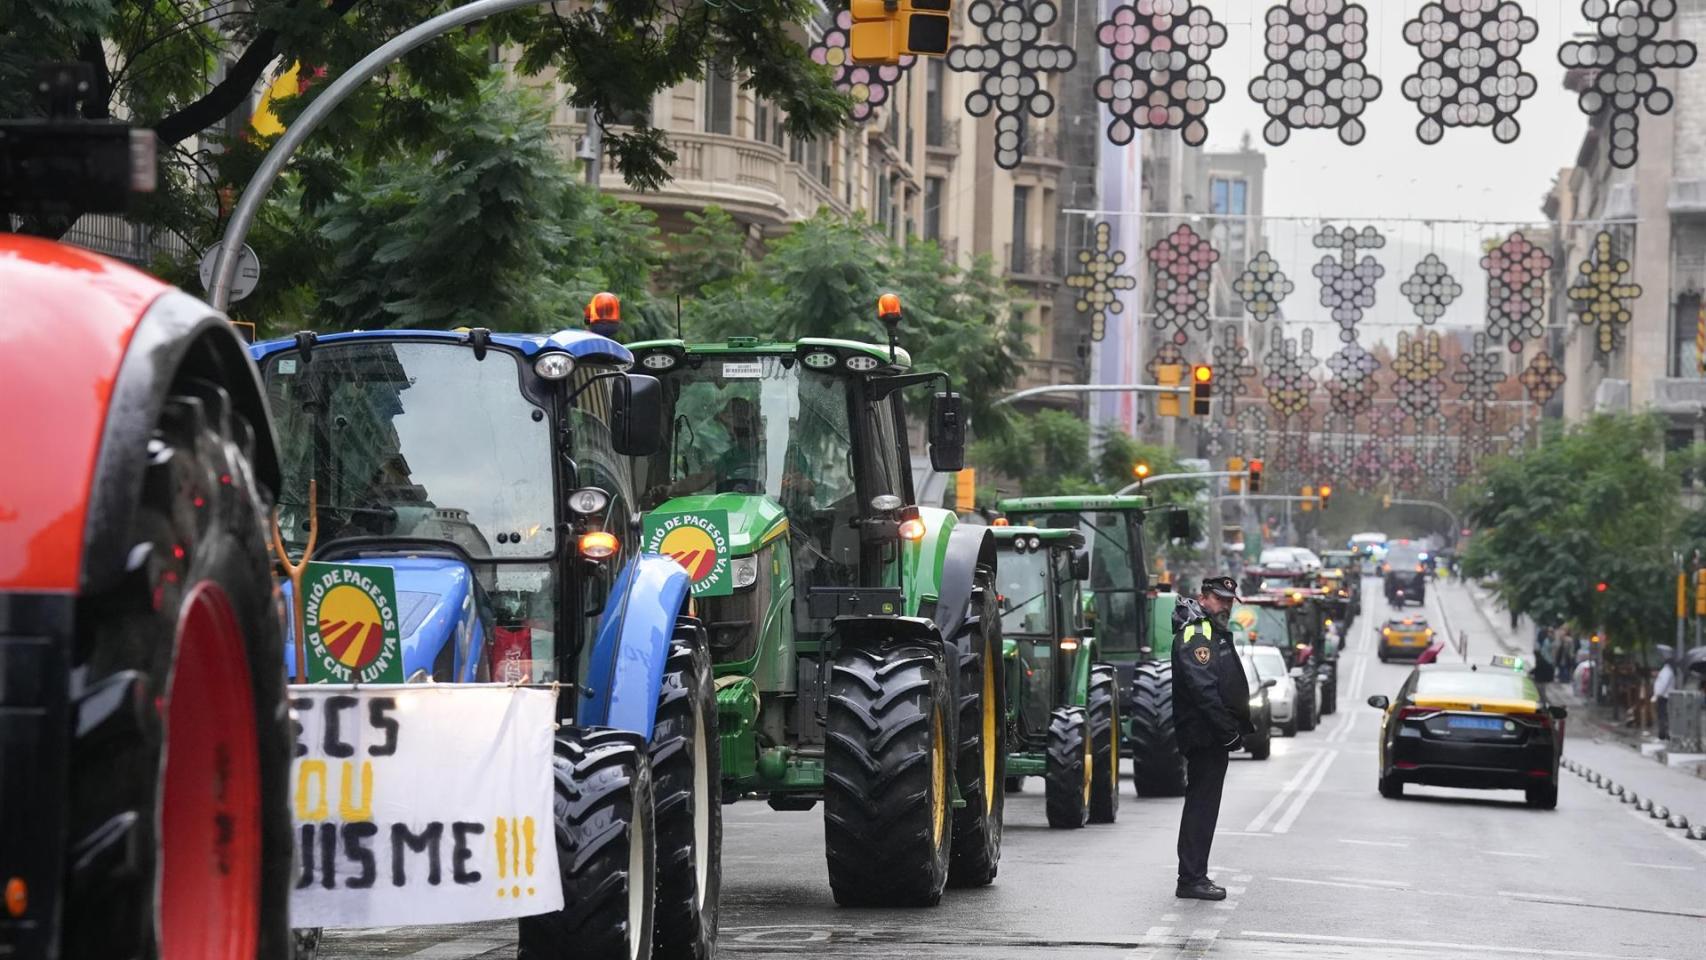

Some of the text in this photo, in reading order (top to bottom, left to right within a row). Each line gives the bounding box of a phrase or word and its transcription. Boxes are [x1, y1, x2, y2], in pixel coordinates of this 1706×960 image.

[664, 516, 682, 530] DE
[683, 515, 727, 554] PAGESOS
[306, 568, 396, 631] UNIÓ DE PAGESOS
[309, 632, 397, 683] DE CATLUNYA
